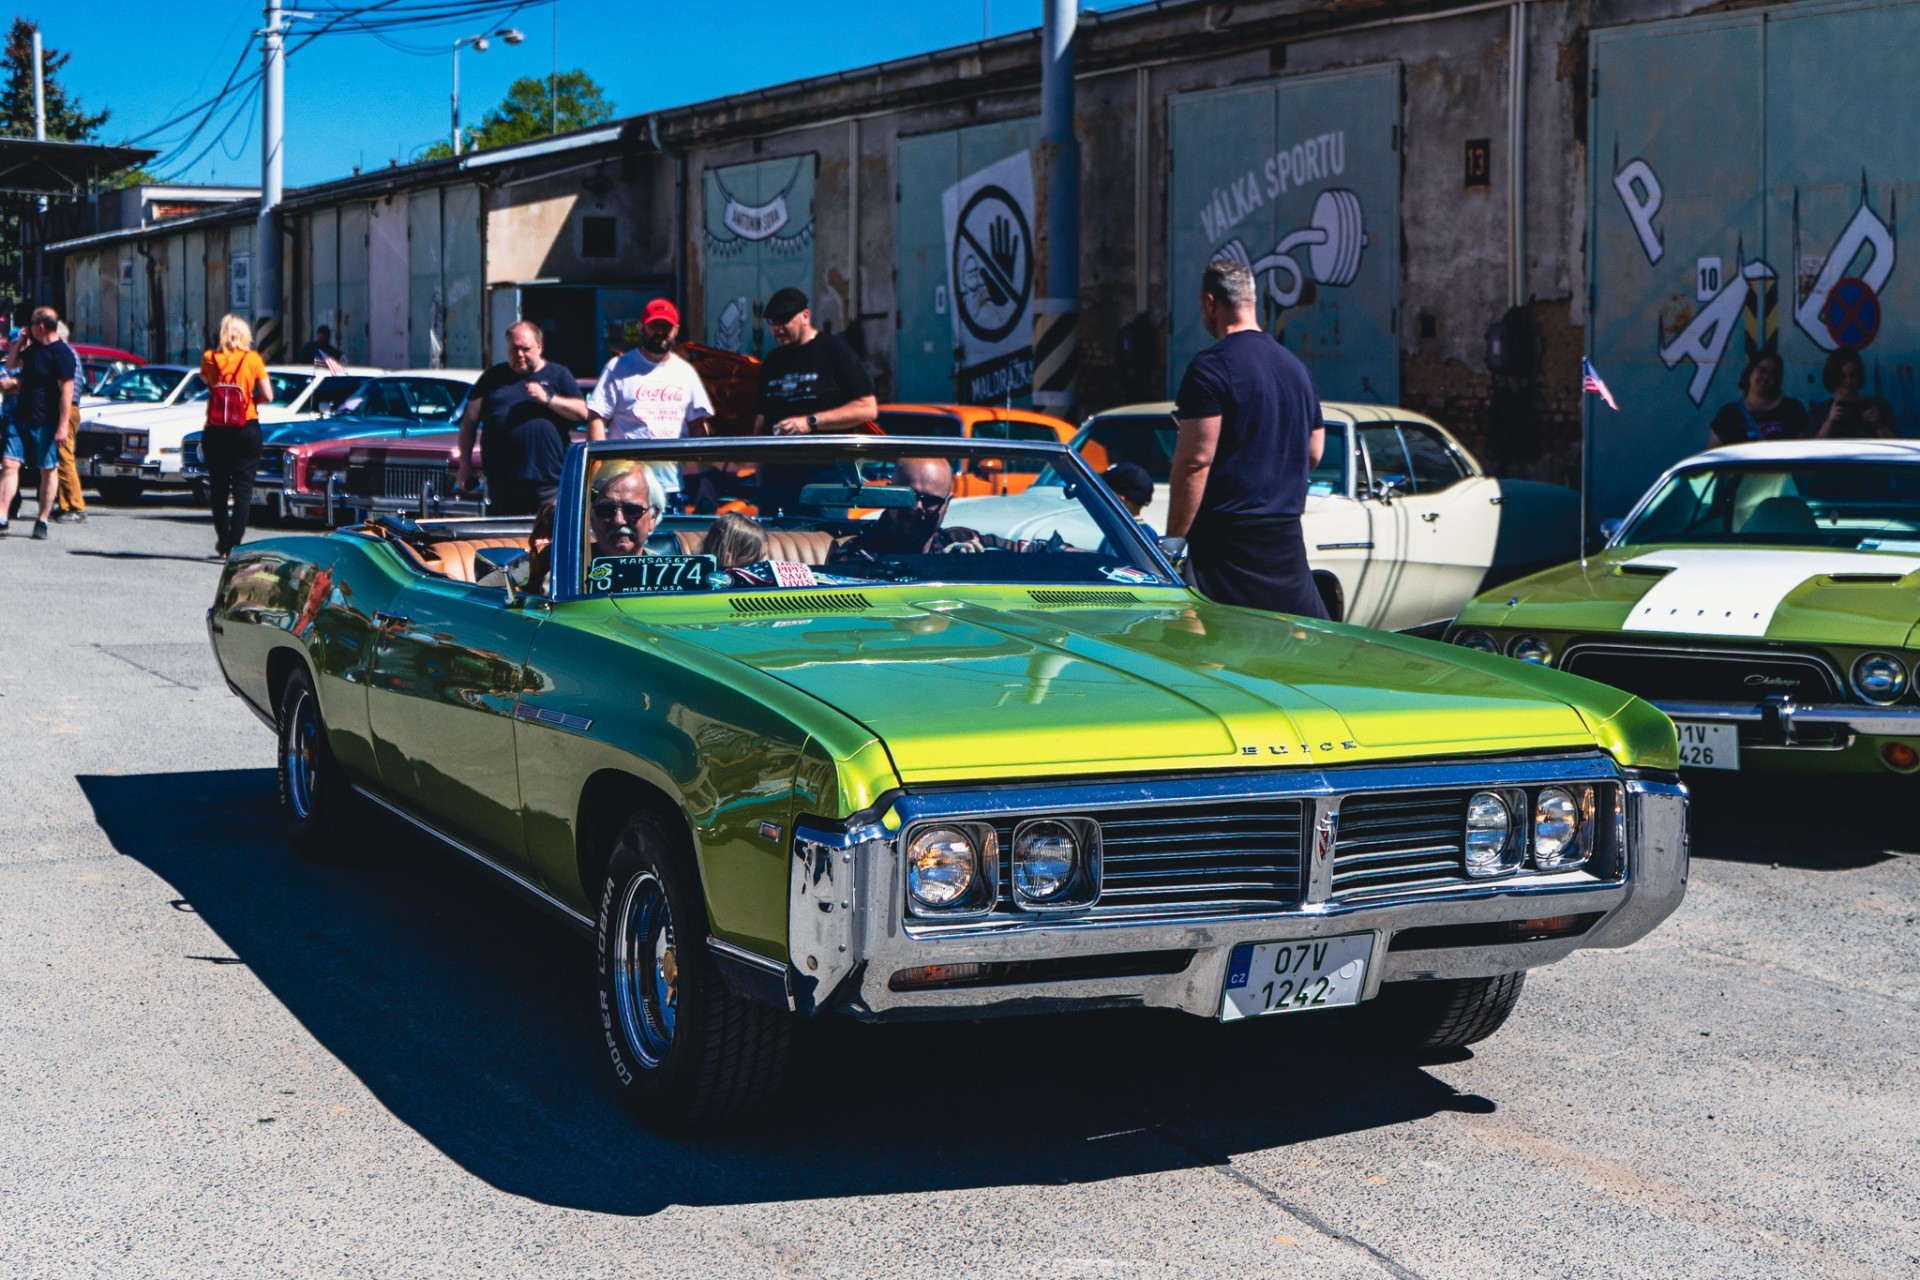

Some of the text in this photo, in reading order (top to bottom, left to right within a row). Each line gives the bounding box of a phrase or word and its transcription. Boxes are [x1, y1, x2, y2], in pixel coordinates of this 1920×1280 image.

[1468, 147, 1486, 177] 13
[1200, 131, 1346, 244] VÁLKA SPORTU
[1700, 266, 1719, 293] 10
[635, 384, 684, 402] Coca-Cola
[619, 557, 673, 565] KANSAS
[777, 566, 808, 574] PIPES
[641, 562, 702, 586] 1774
[780, 573, 809, 581] SAVE
[1241, 740, 1357, 756] BUICK
[1273, 941, 1329, 975] 07V
[597, 876, 634, 1087] COOPER COBRA
[1230, 972, 1246, 985] CZ
[1261, 975, 1331, 1010] 1242
